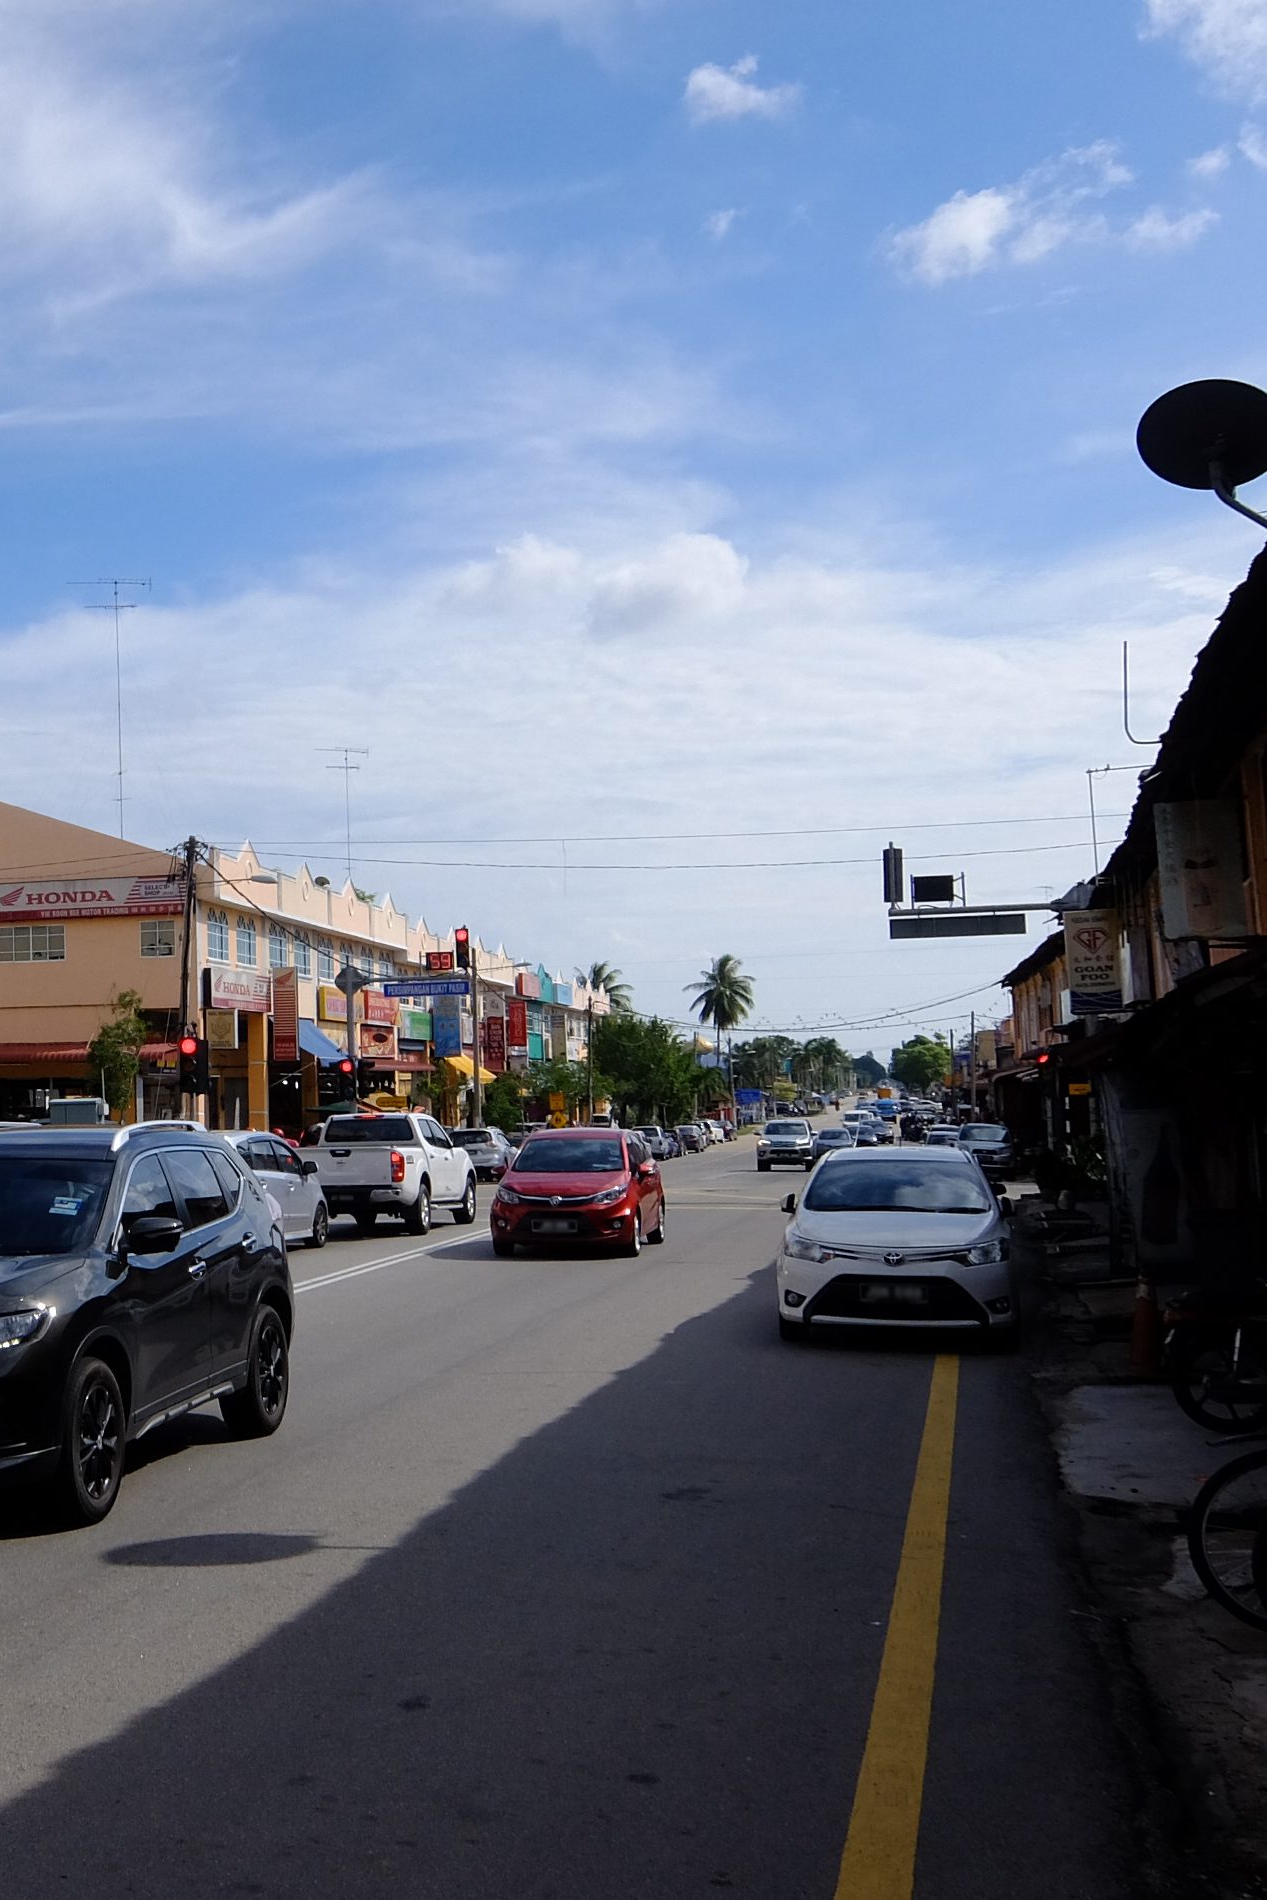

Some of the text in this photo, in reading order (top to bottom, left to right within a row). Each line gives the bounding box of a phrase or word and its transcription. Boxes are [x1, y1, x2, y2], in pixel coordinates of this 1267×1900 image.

[25, 890, 115, 905] HONDA
[81, 908, 102, 916] MOTOR
[103, 907, 129, 915] TRADING
[429, 953, 451, 969] 59
[1074, 965, 1114, 974] GOAN
[1080, 973, 1110, 981] FOO
[223, 981, 251, 996] HONDA
[387, 983, 466, 996] PERSIMPANGAN BUKIT PASIR
